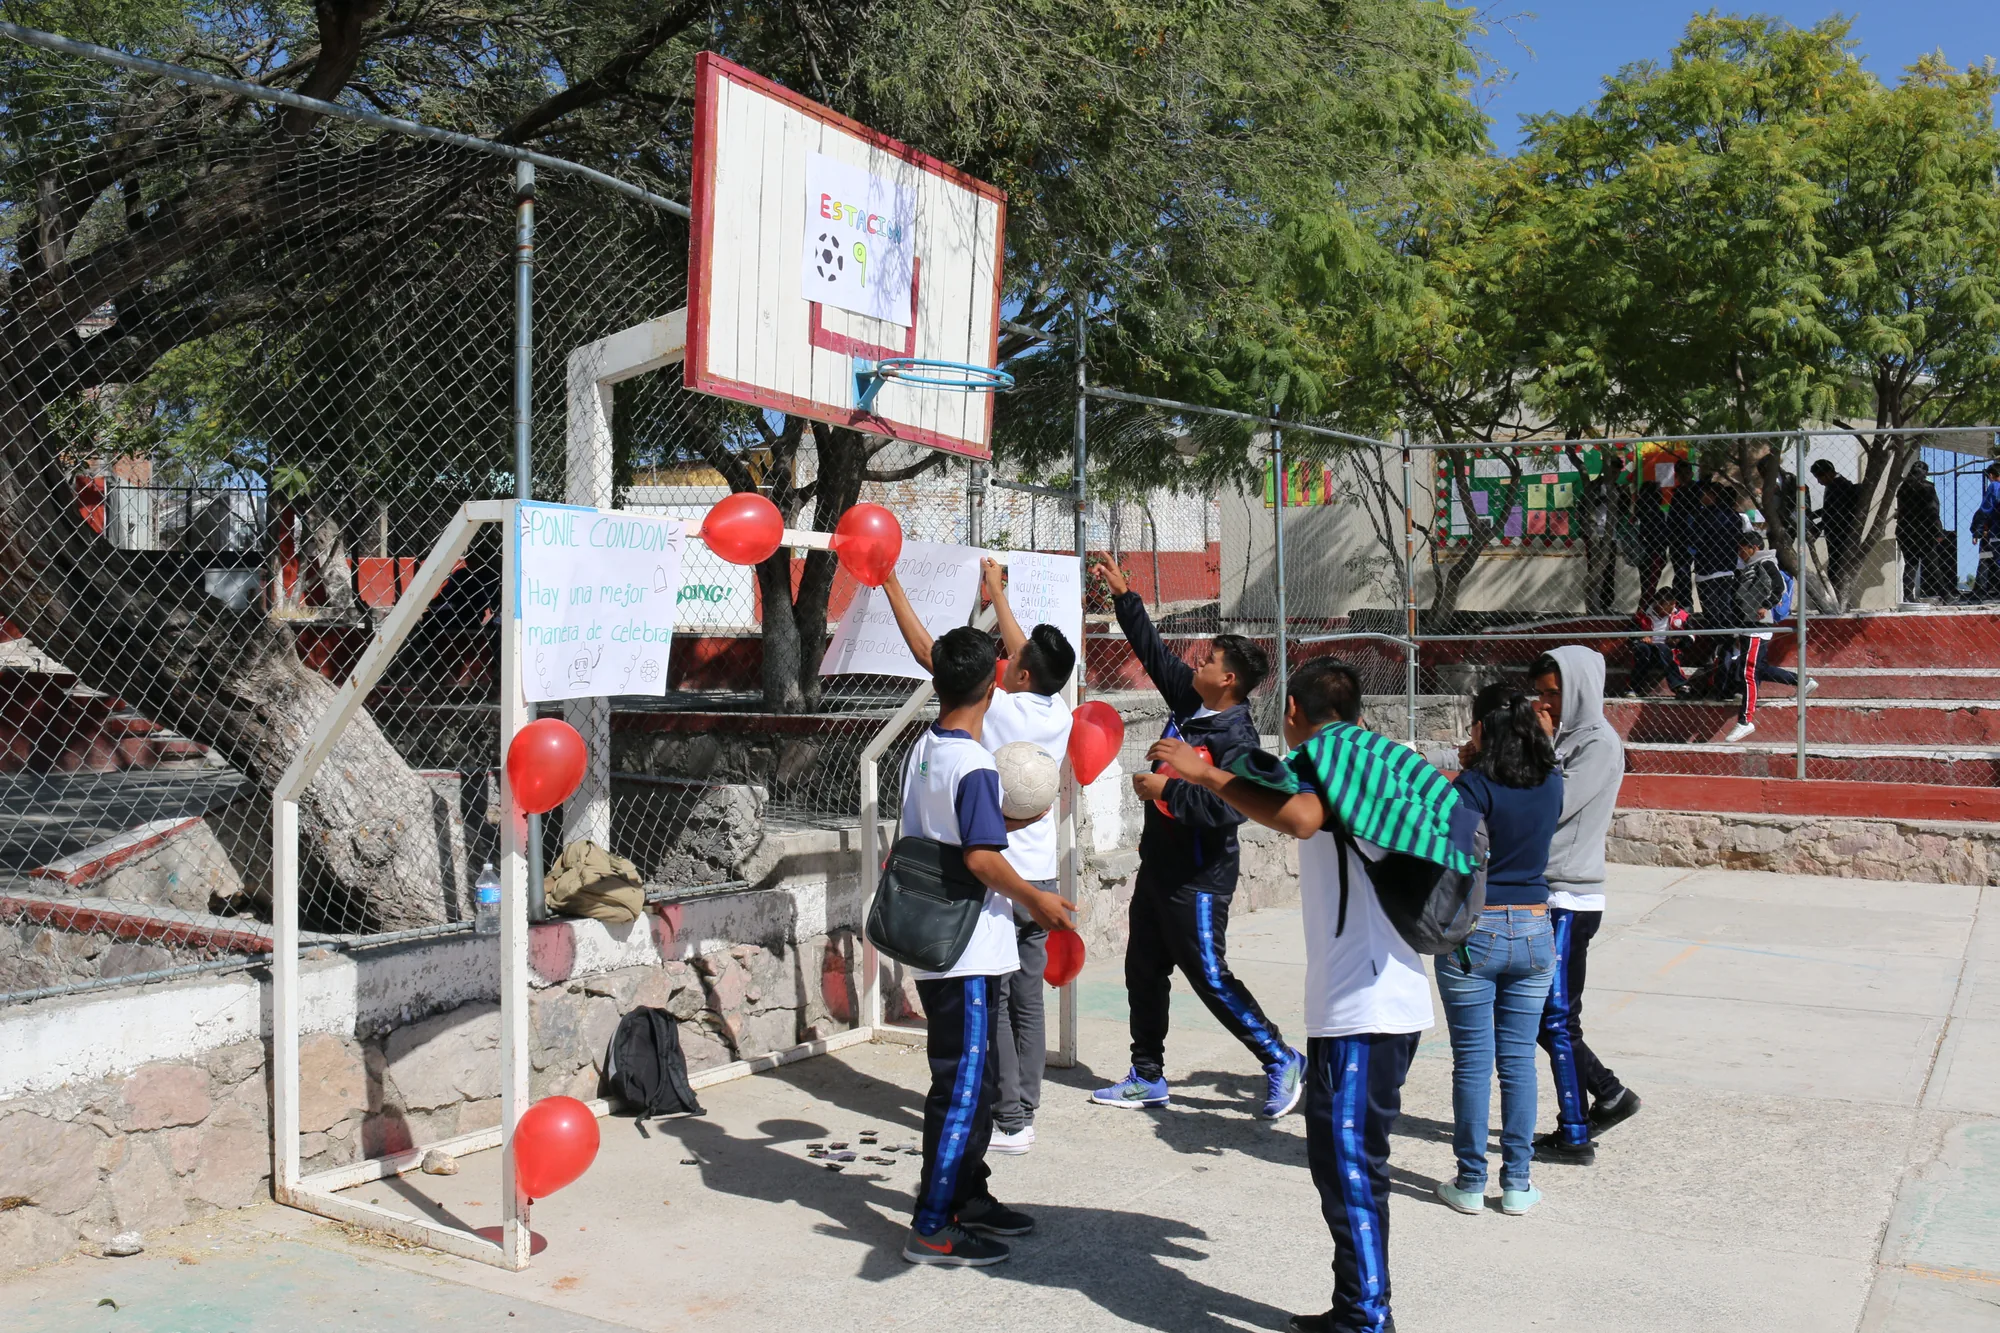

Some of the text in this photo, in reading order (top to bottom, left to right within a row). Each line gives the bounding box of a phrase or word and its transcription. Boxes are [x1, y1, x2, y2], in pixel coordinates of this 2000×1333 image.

[853, 242, 867, 288] 9
[589, 517, 669, 552] CONDON
[933, 561, 962, 581] por
[528, 577, 649, 612] Hay una mejor
[528, 625, 579, 646] manera
[586, 618, 602, 641] de
[852, 608, 934, 629] sexuale y
